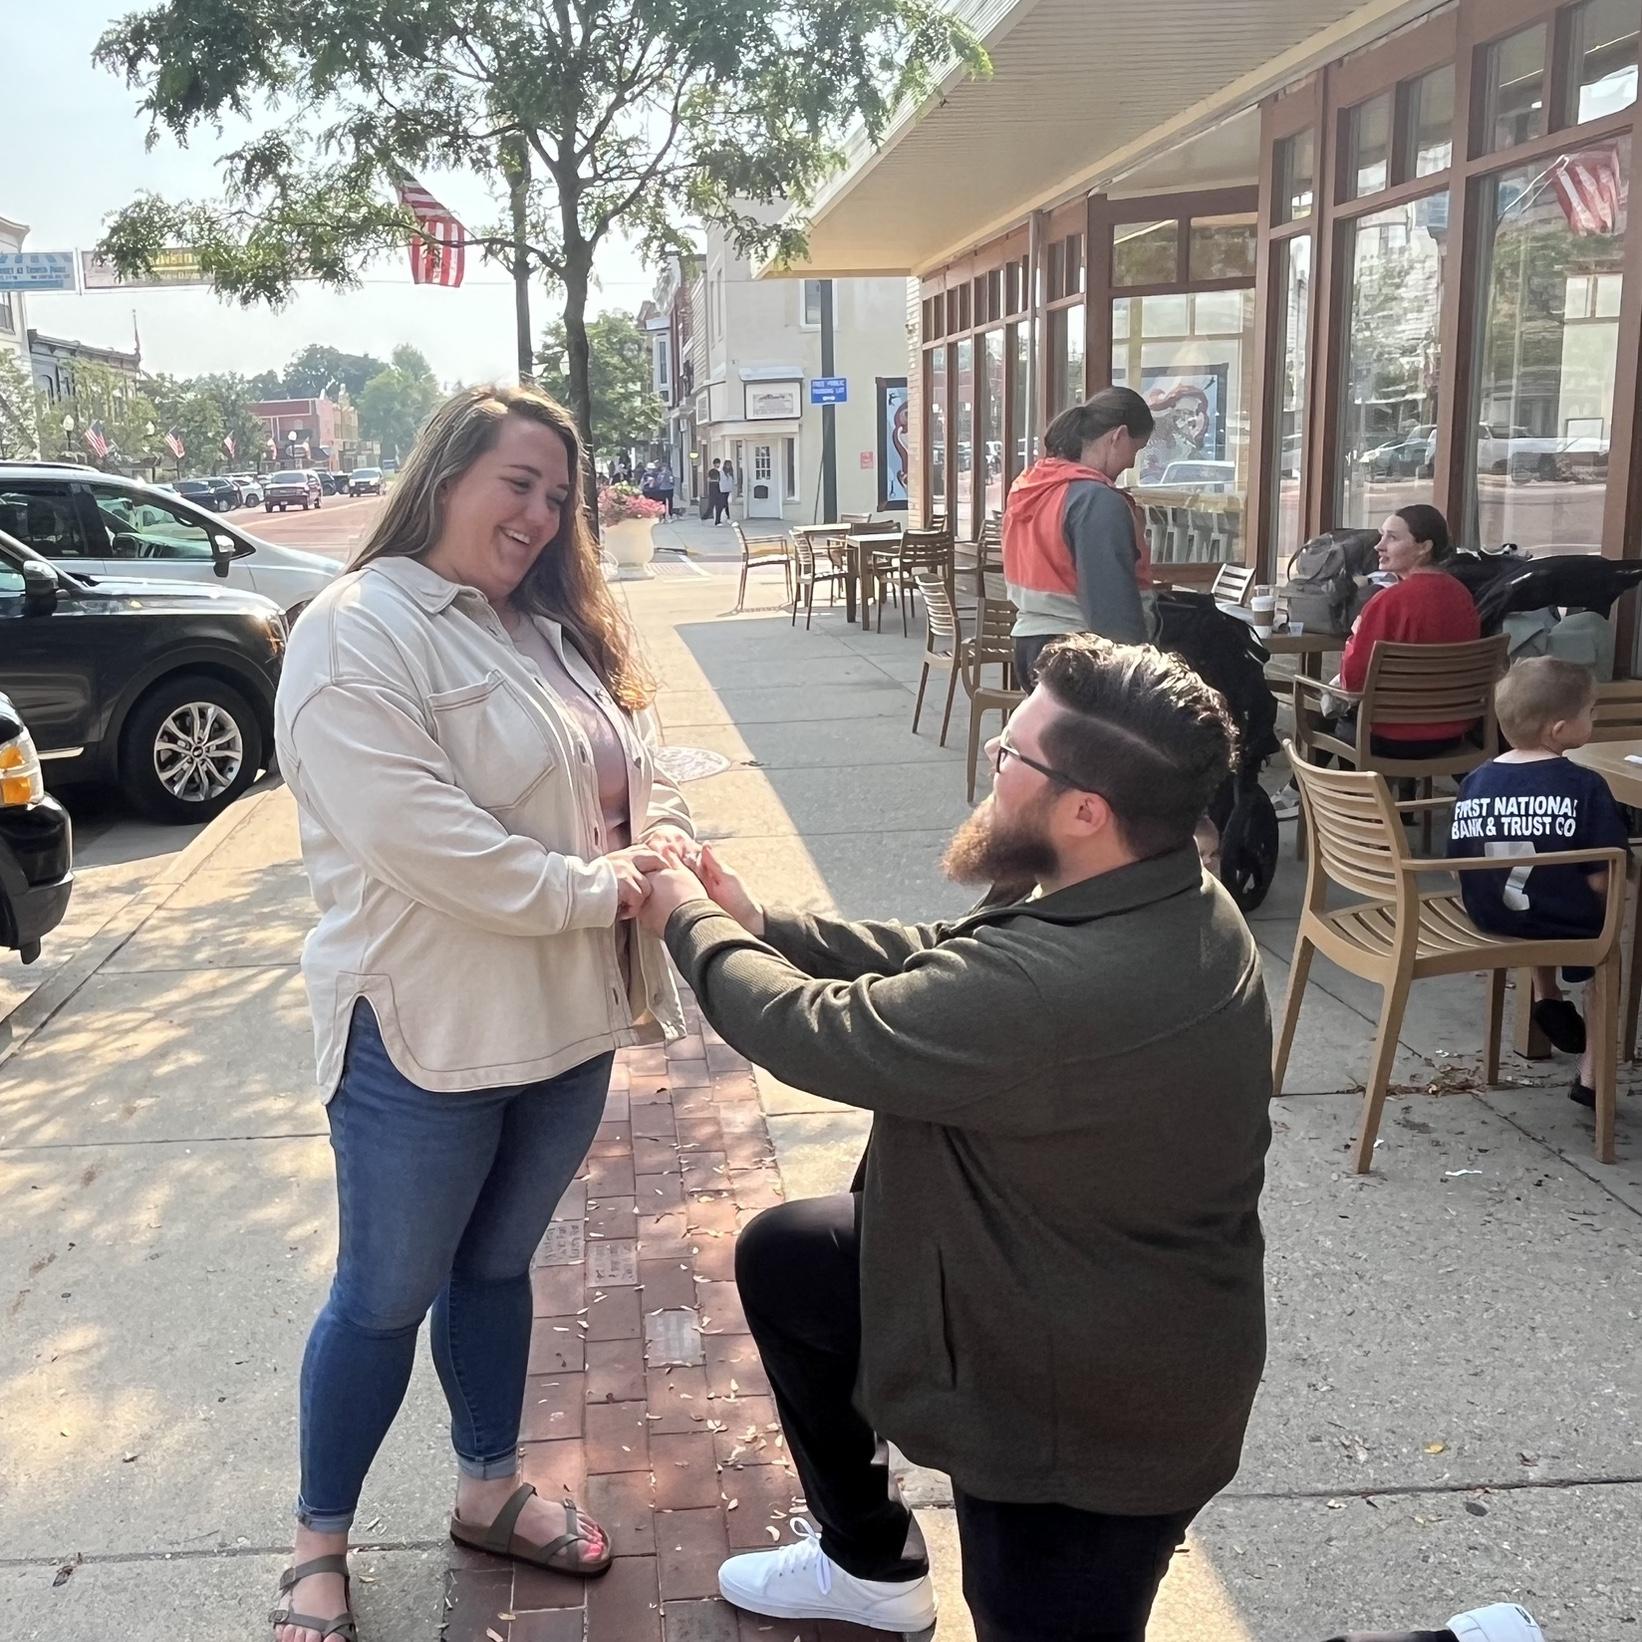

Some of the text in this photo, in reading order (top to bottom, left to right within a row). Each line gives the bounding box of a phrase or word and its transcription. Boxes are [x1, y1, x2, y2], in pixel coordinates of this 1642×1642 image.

[1454, 798, 1491, 820] FIRST
[1451, 816, 1576, 840] BANK & TRUST CO
[1484, 841, 1536, 911] 7
